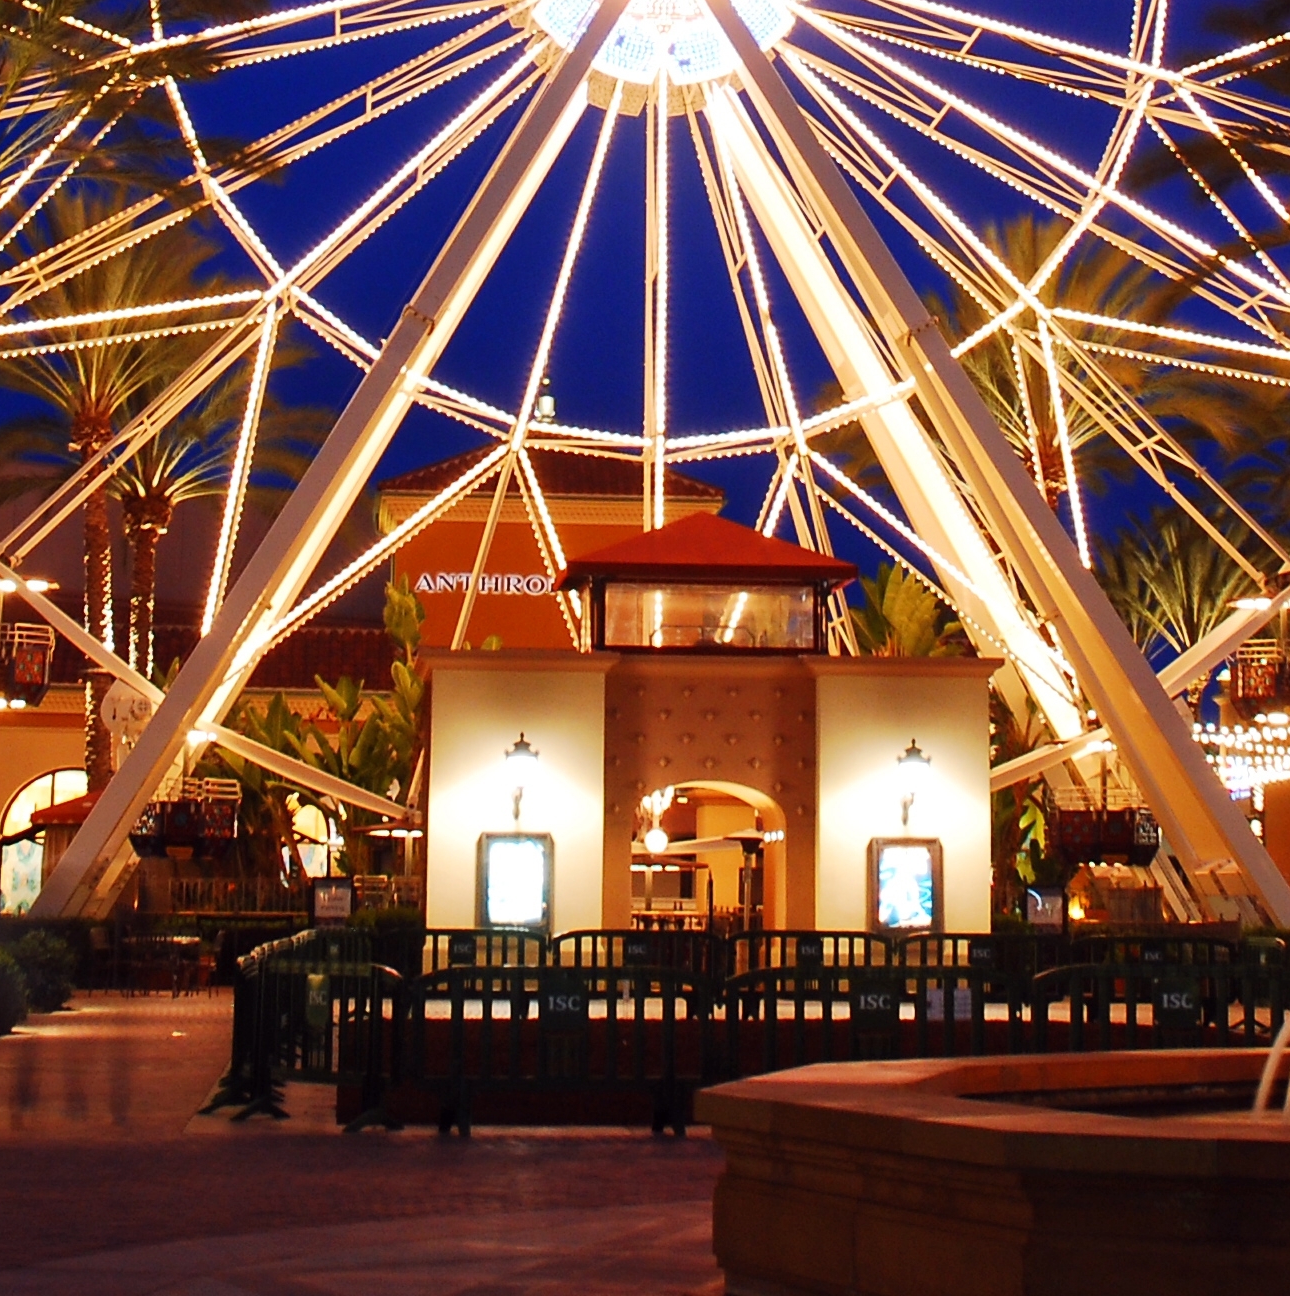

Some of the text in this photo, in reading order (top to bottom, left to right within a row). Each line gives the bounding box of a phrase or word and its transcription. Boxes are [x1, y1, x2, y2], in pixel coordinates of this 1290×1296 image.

[415, 571, 557, 596] ANTHRO
[972, 948, 991, 958] ISC
[548, 994, 581, 1011] ISC
[859, 994, 892, 1010] ISC
[1162, 993, 1194, 1009] ISC
